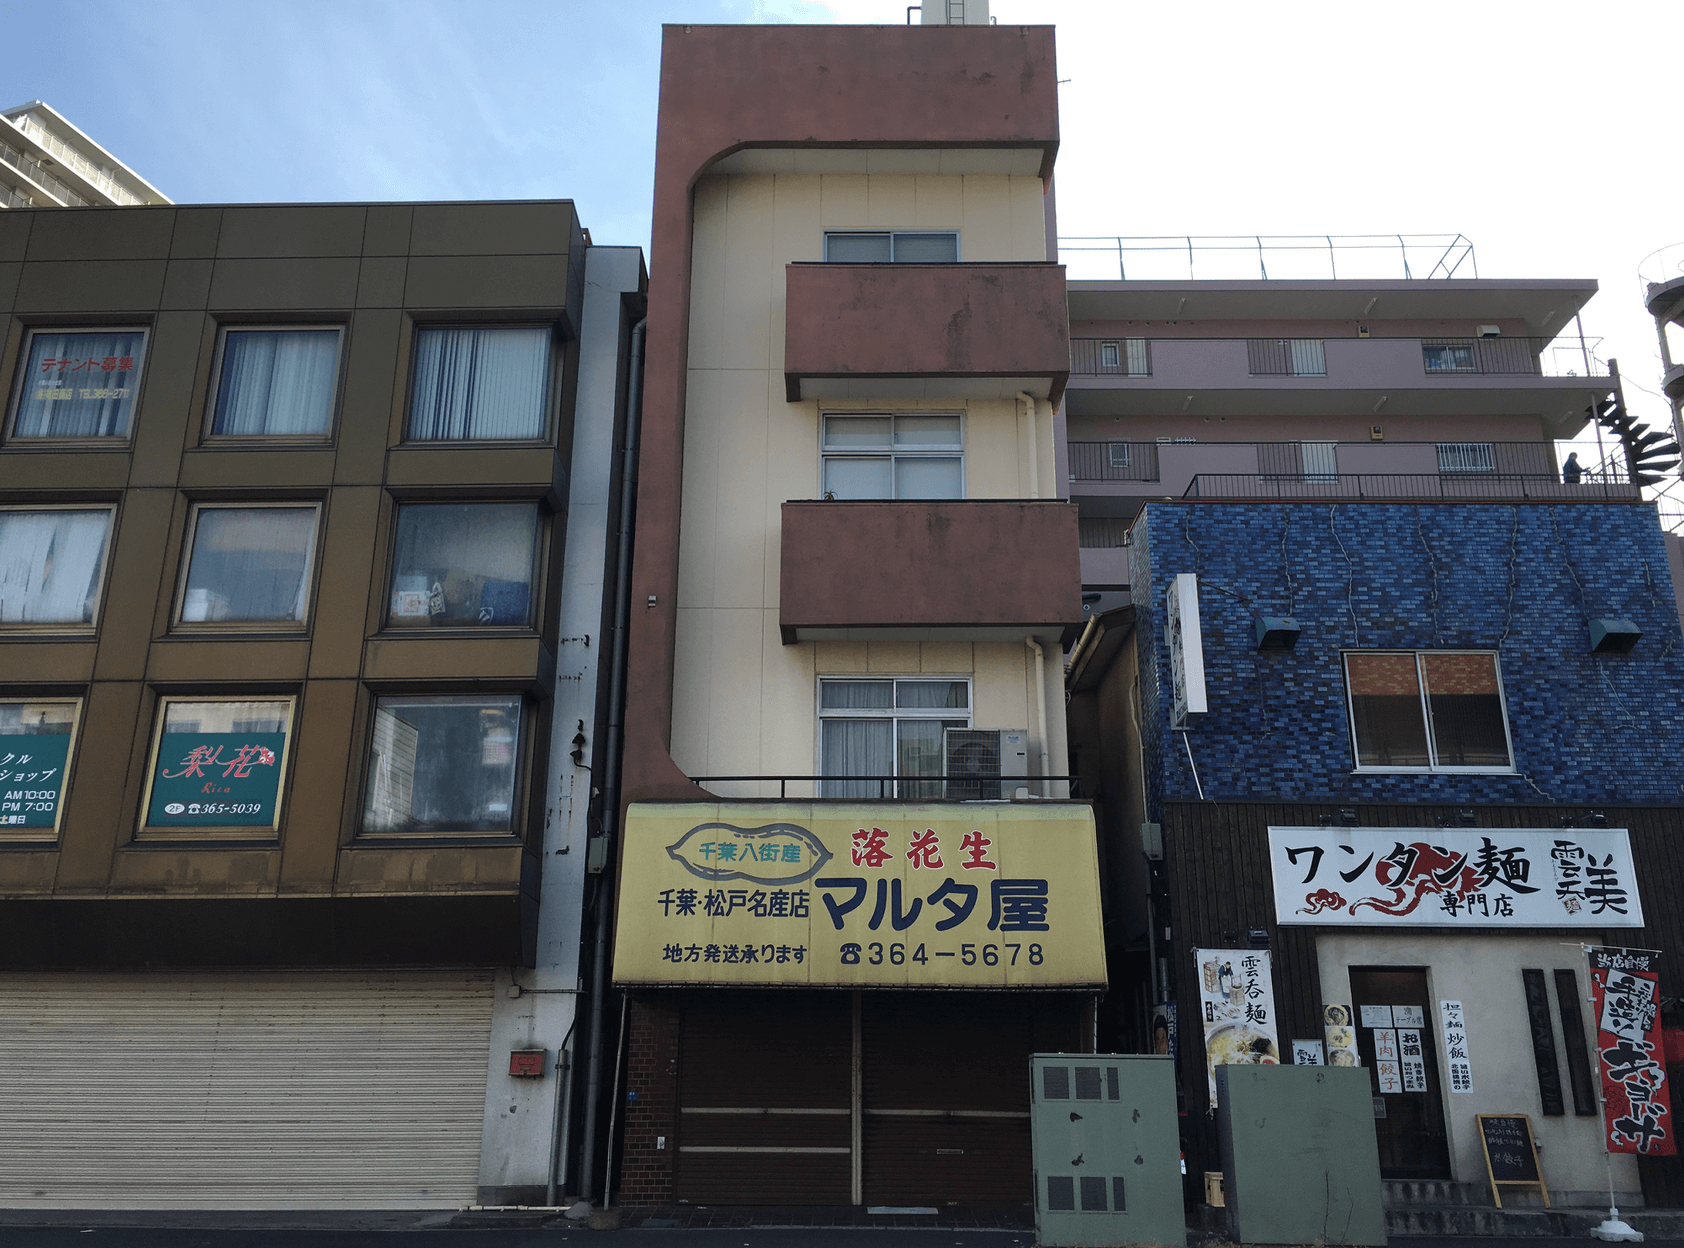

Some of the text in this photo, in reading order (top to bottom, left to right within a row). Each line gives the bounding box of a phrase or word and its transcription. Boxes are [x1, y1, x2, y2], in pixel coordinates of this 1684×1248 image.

[41, 356, 134, 373] テナント募集
[162, 744, 274, 778] 梨花
[201, 782, 231, 794] Rica
[1, 802, 54, 812] PM 7:00
[200, 802, 261, 815] 365-5039
[699, 841, 801, 864] 千葉八街産
[850, 827, 997, 870] 落花生
[1284, 836, 1542, 895] ワンタン麺
[814, 877, 1050, 932] マルタ屋
[1440, 892, 1515, 918] 専門店
[662, 943, 807, 965] 地方発送承ります
[867, 942, 1044, 967] 364-5678
[1596, 953, 1650, 972] 当店自慢
[1241, 955, 1268, 1025] 雲呑麺
[1402, 1033, 1420, 1056] お酒
[1447, 1032, 1468, 1059] 炒飯
[1379, 1063, 1398, 1090] 餃子
[1601, 1039, 1668, 1153] ギョーザ
